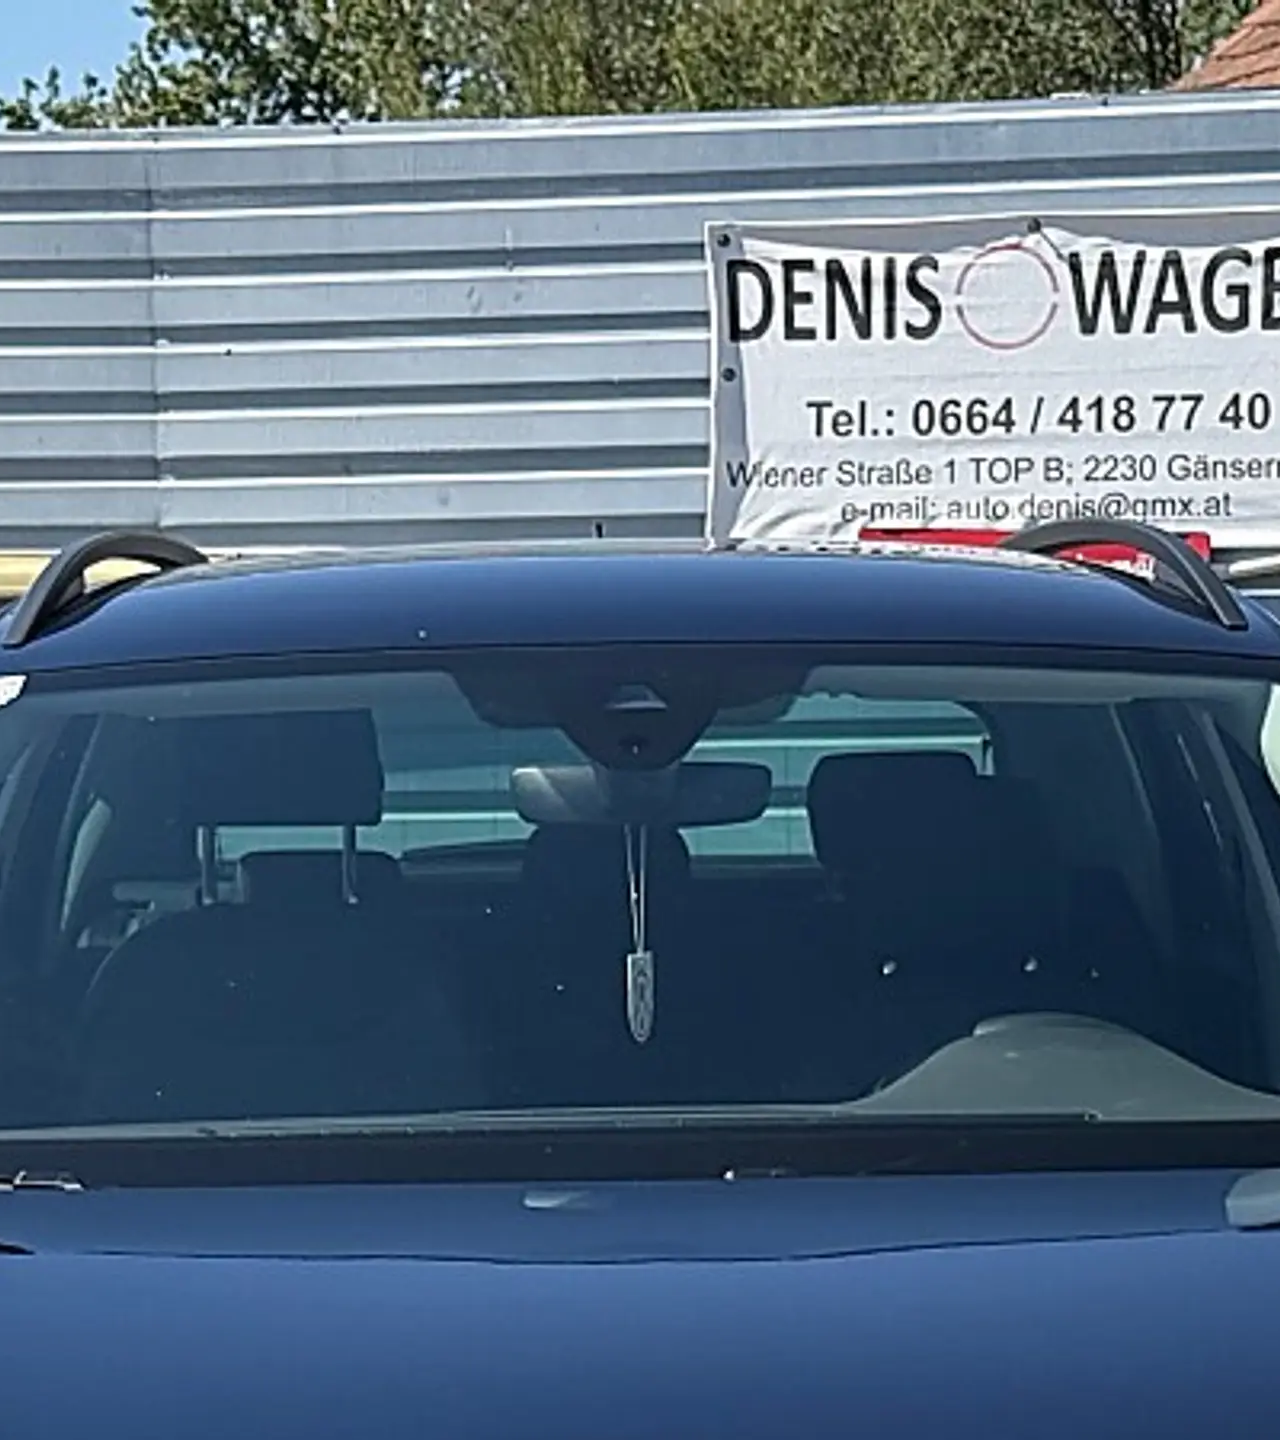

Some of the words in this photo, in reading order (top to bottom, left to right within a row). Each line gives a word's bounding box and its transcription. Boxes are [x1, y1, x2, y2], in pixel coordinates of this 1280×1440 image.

[725, 255, 943, 342] DENIS
[806, 400, 895, 437] Tel.:
[912, 397, 1016, 435] 0664
[1030, 396, 1044, 434] /
[1056, 394, 1136, 433] 418
[1152, 394, 1204, 431] 77
[1219, 392, 1271, 430] 40
[726, 460, 829, 488] Wiener
[835, 458, 933, 487] Straße
[945, 459, 956, 484] 1
[969, 457, 1034, 484] TOP
[1043, 456, 1073, 485] B;
[1083, 454, 1157, 482] 2230
[841, 495, 937, 523] e-mail:
